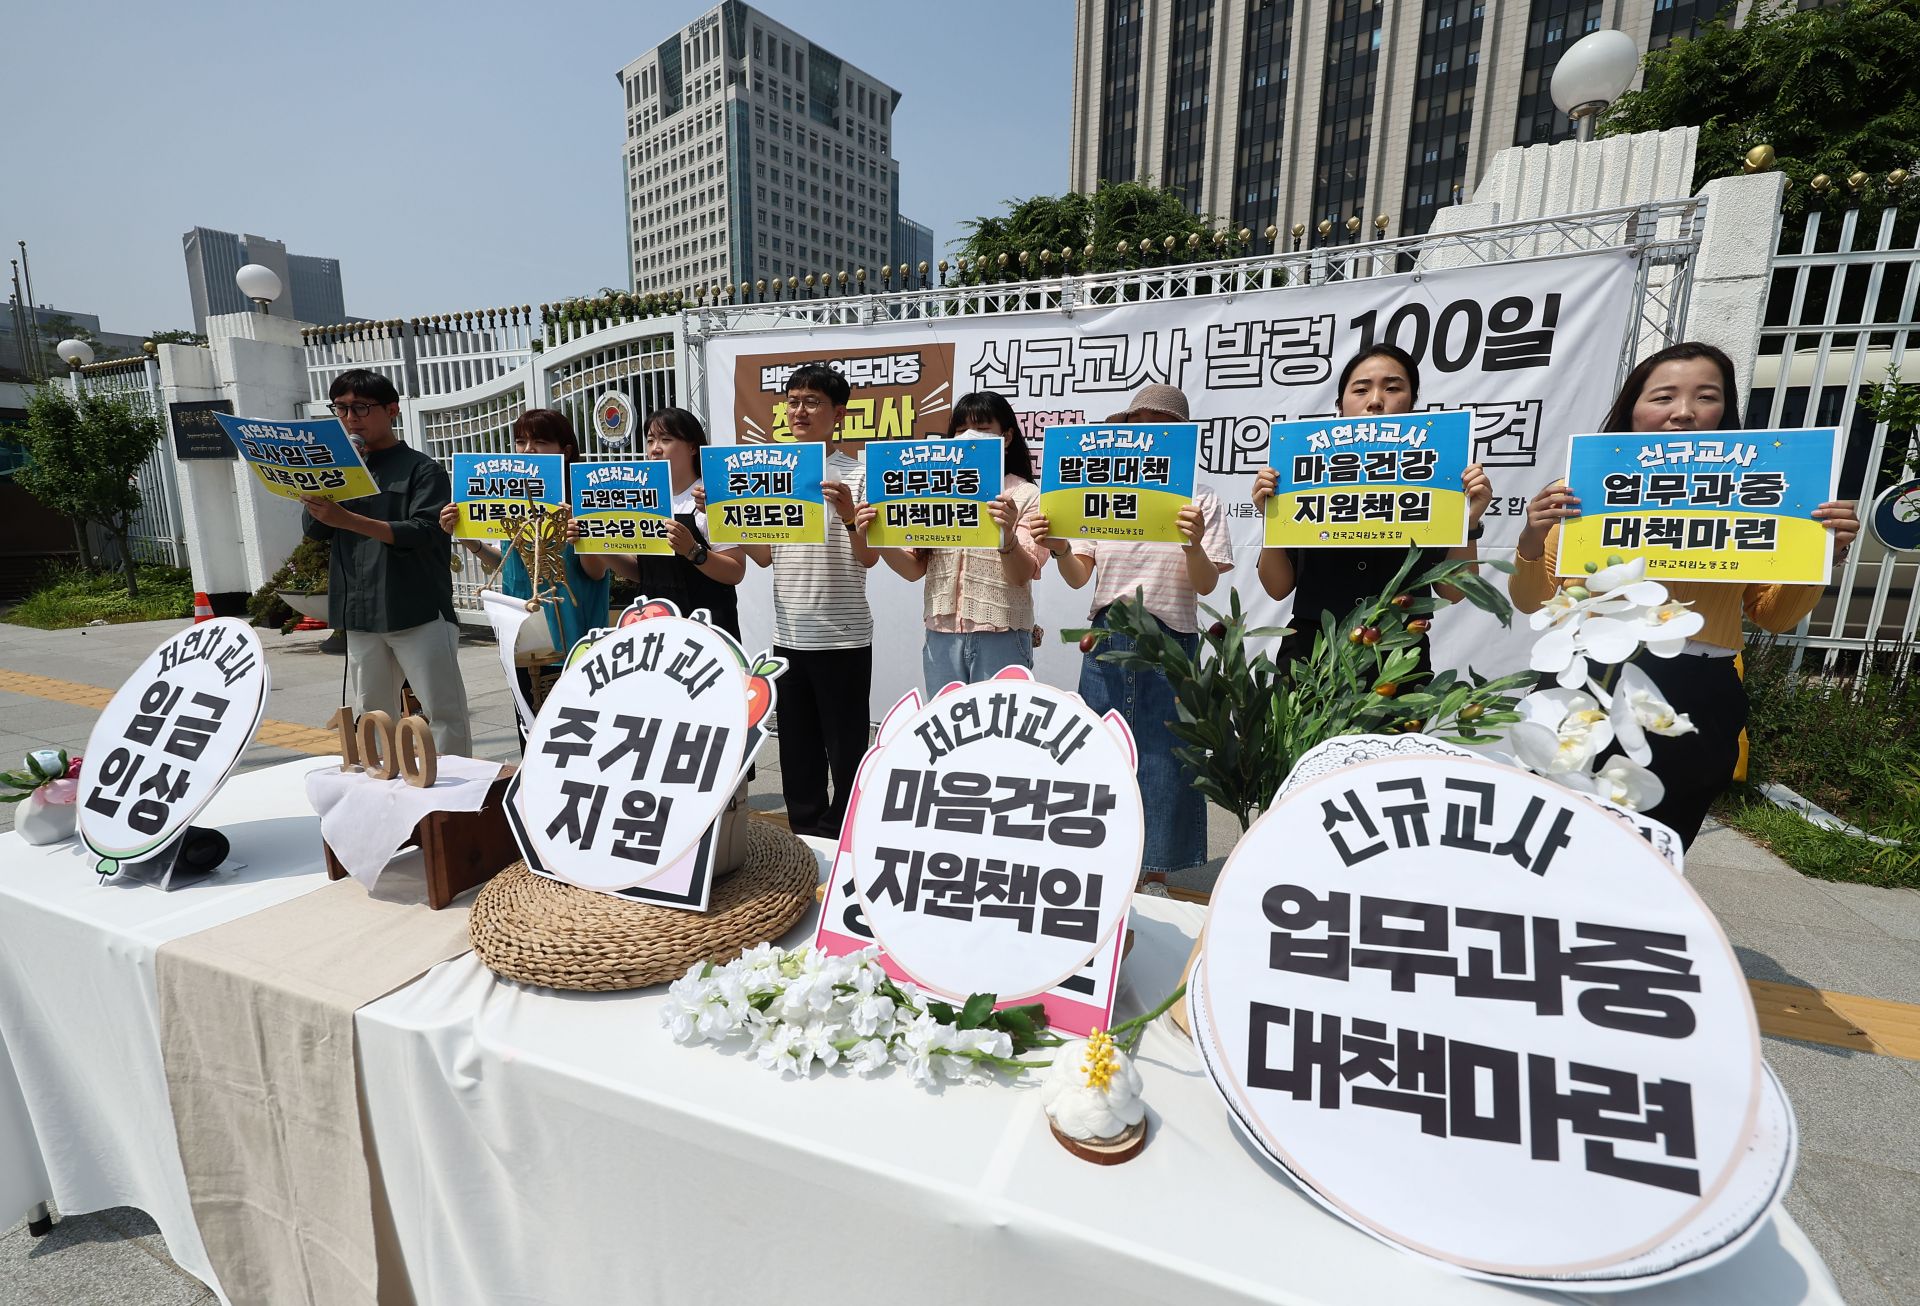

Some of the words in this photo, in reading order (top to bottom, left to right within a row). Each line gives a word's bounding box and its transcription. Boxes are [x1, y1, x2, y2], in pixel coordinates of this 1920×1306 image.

[970, 328, 1192, 397] 신규교사
[1205, 314, 1336, 390] 발령
[1350, 293, 1561, 373] 100일
[237, 424, 315, 445] 저연차교사
[1078, 429, 1154, 452] 신규교사
[1306, 423, 1428, 452] 저연차교사
[240, 438, 335, 466] 교사임금
[724, 449, 798, 471] 저연차교사
[899, 444, 964, 465] 신규교사
[1636, 440, 1758, 468] 신규교사
[258, 464, 347, 491] 대폭인상
[474, 459, 539, 478] 저연차교사
[587, 466, 648, 486] 저연차교사
[1058, 456, 1170, 485] 발령대책
[1292, 449, 1438, 485] 마음건강
[467, 478, 545, 498] 교사임금
[728, 470, 793, 497] 주거비
[882, 469, 980, 496] 업무과중
[1603, 472, 1784, 507] 업무과중
[581, 488, 658, 509] 교원연구비
[1083, 492, 1138, 520] 마련
[1293, 491, 1431, 524] 지원책임
[722, 503, 804, 528] 지원도입
[885, 502, 979, 528] 대책마련
[1332, 531, 1402, 540] 전국교직원노동조합
[1602, 517, 1777, 551] 대책마련
[1648, 559, 1739, 570] 전국교직원노동조합
[124, 680, 230, 761] 임금
[327, 706, 437, 788] 100
[541, 706, 730, 792] 주거비
[85, 747, 190, 835] 인상
[881, 768, 1116, 849] 마음건강
[545, 780, 674, 866] 지원
[1321, 776, 1574, 877] 신규교사
[865, 846, 1103, 943] 지원책임
[1261, 883, 1701, 1039] 업무과중
[1246, 1001, 1701, 1198] 대책마련
